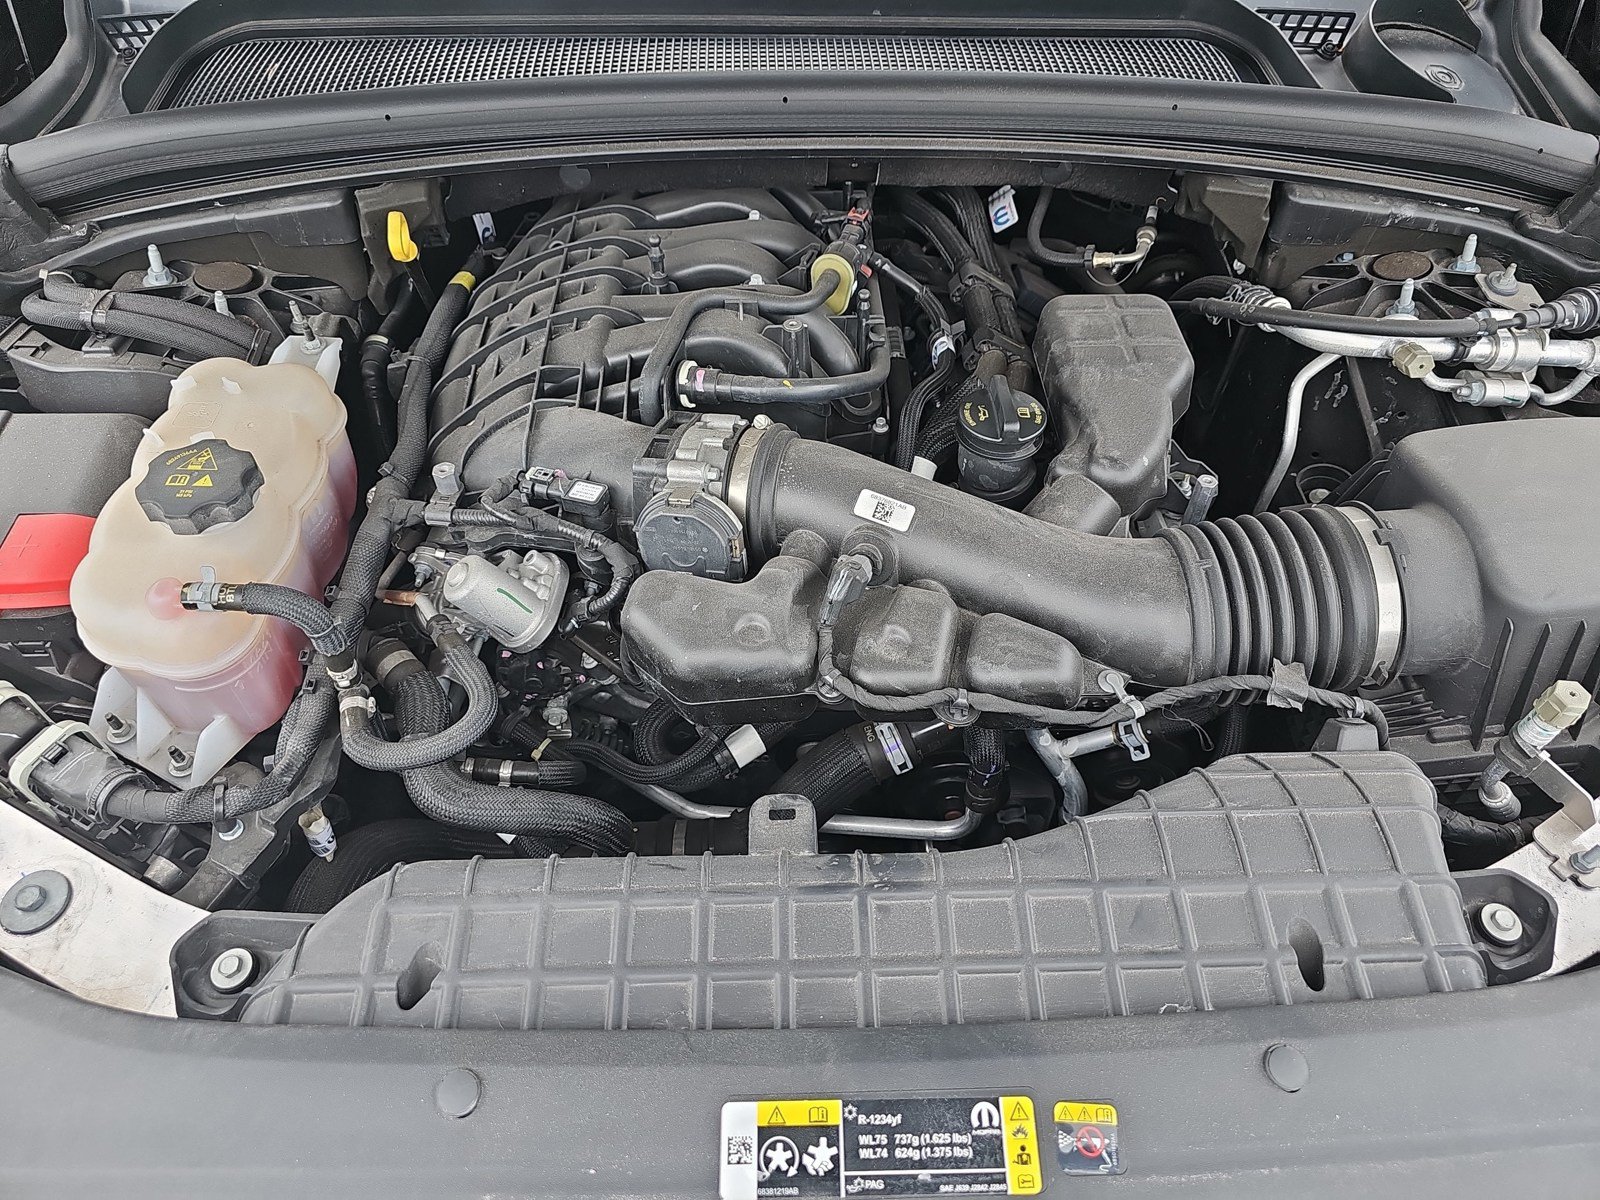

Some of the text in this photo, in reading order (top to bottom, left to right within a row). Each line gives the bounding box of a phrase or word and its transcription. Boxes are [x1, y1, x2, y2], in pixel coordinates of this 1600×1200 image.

[863, 725, 876, 743] ENG
[857, 1113, 902, 1127] R-1234yf
[858, 1132, 972, 1146] WL75 737g (1.625 lbs)
[858, 1146, 974, 1160] WL74 624g (1.375 lbs)
[865, 1179, 885, 1190] PAG
